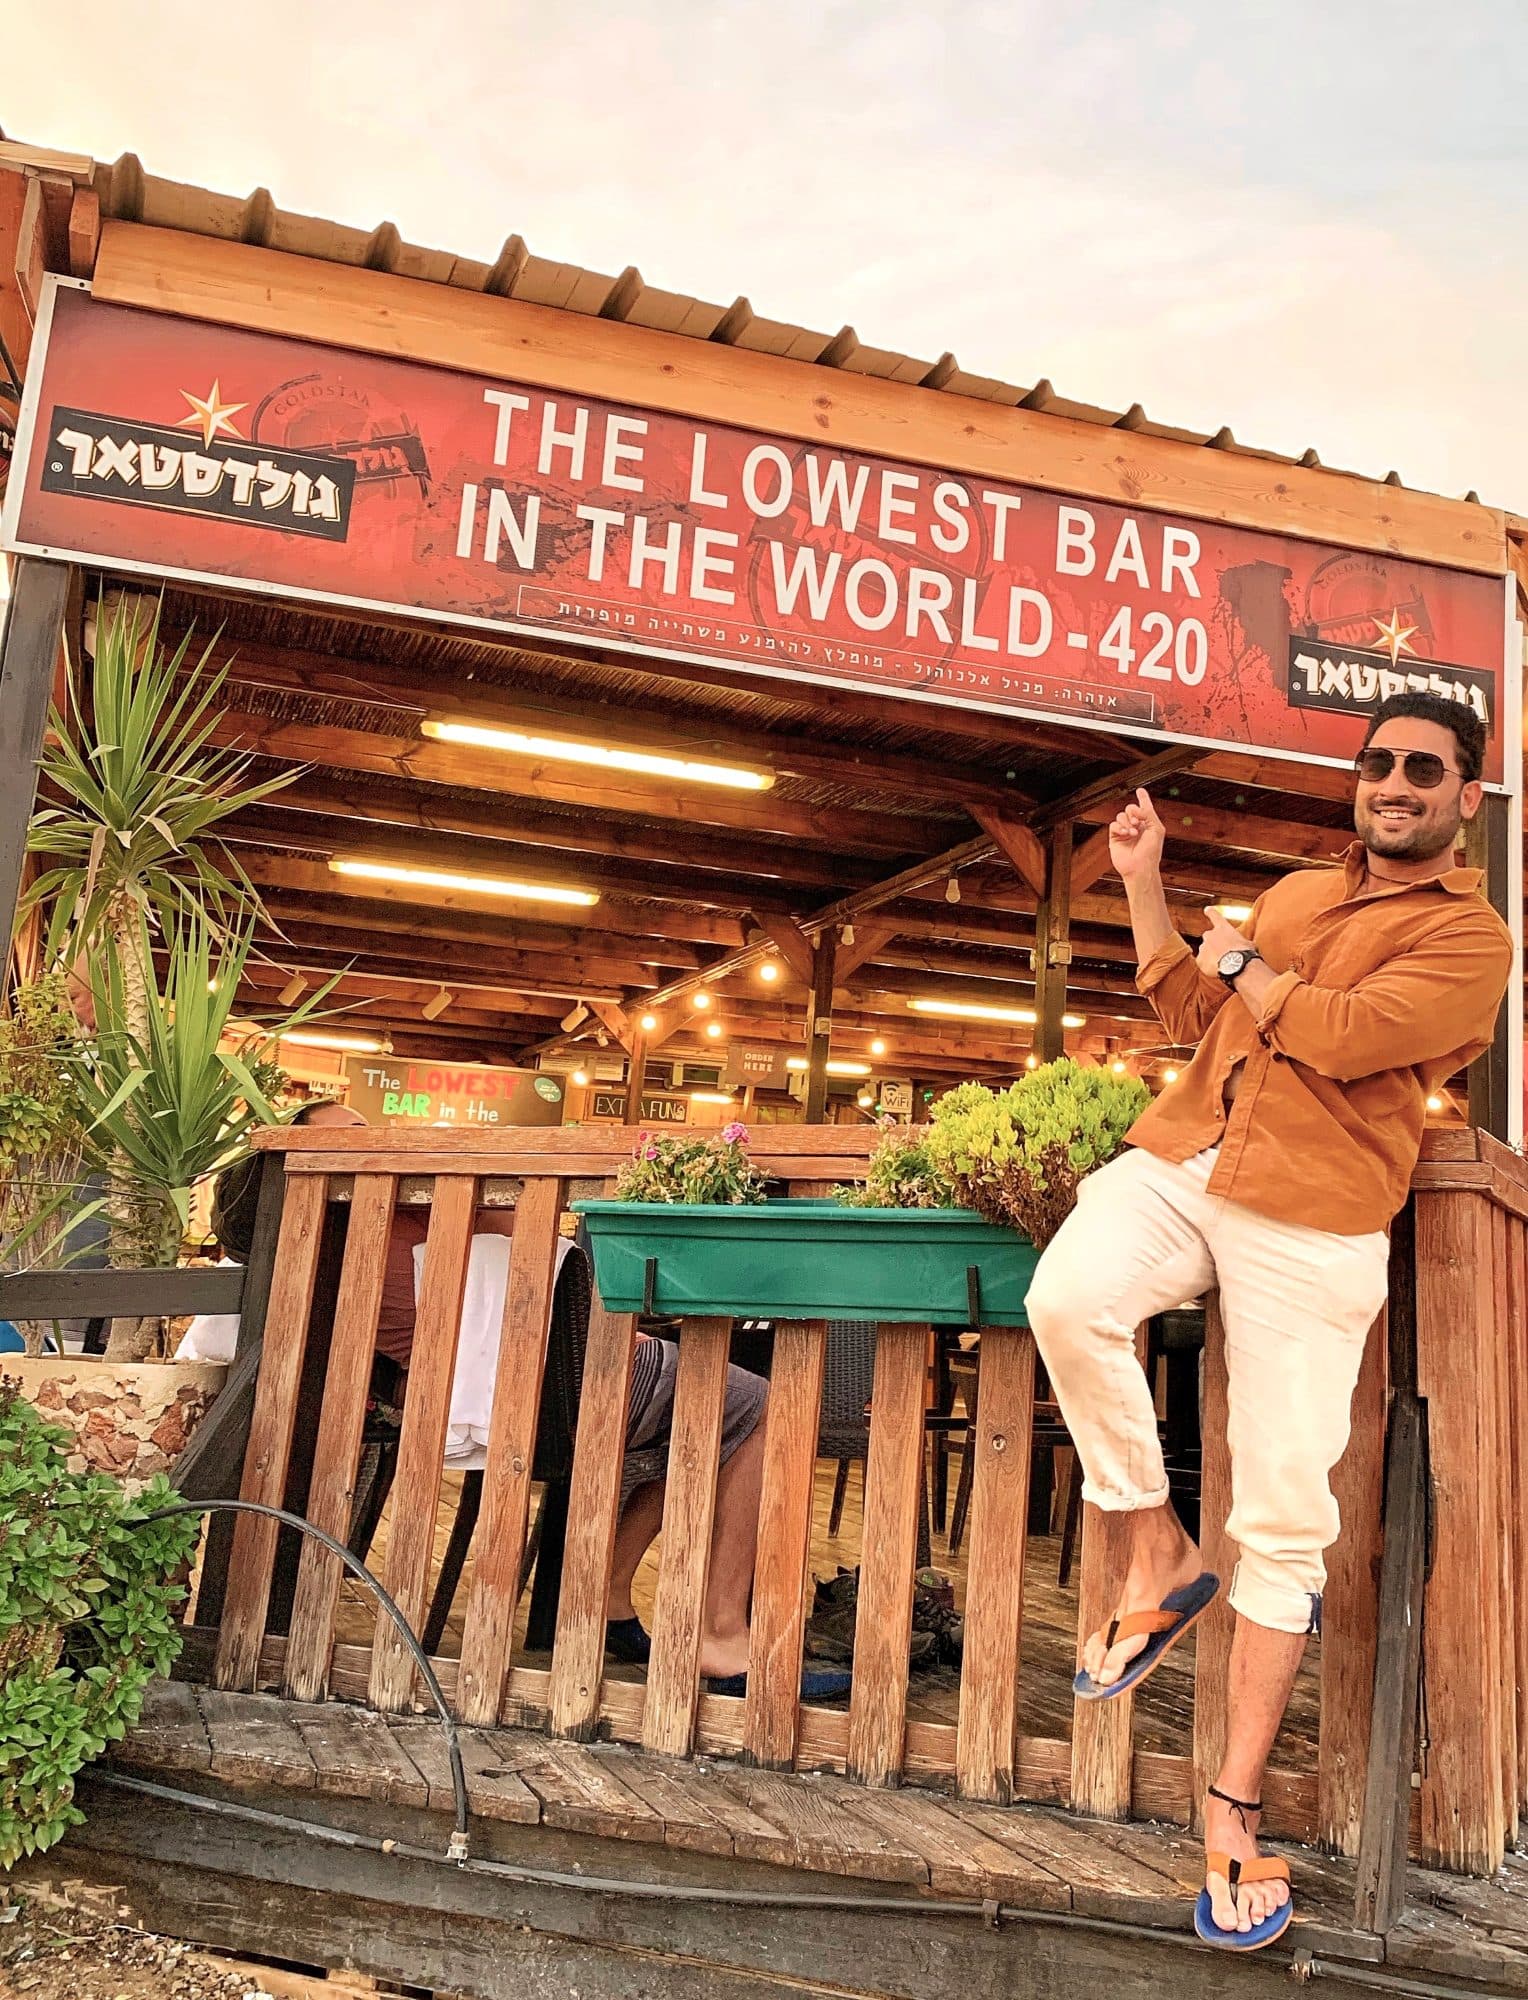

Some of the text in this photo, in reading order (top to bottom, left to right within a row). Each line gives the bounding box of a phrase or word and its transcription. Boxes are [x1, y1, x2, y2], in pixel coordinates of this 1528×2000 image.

[56, 427, 342, 522] גולדסטאר
[484, 389, 1201, 598] THE LOWEST BAR
[456, 483, 541, 570] IN
[576, 504, 739, 605] THE
[770, 541, 1053, 657] WORLD
[558, 602, 636, 626] מופרזת
[648, 617, 727, 642] משתייה
[739, 633, 812, 656] להימנע
[824, 647, 883, 668] מומלץ
[913, 661, 991, 686] אלכוהול
[1002, 676, 1044, 695] מכיל
[1055, 688, 1118, 707] אזהרה:
[743, 1061, 772, 1072] HERE
[744, 1052, 774, 1063] ORDER
[363, 1068, 401, 1090] The
[407, 1064, 521, 1100] LOWEST
[382, 1092, 499, 1122] BAR in the
[596, 1096, 676, 1119] EXTA FUN
